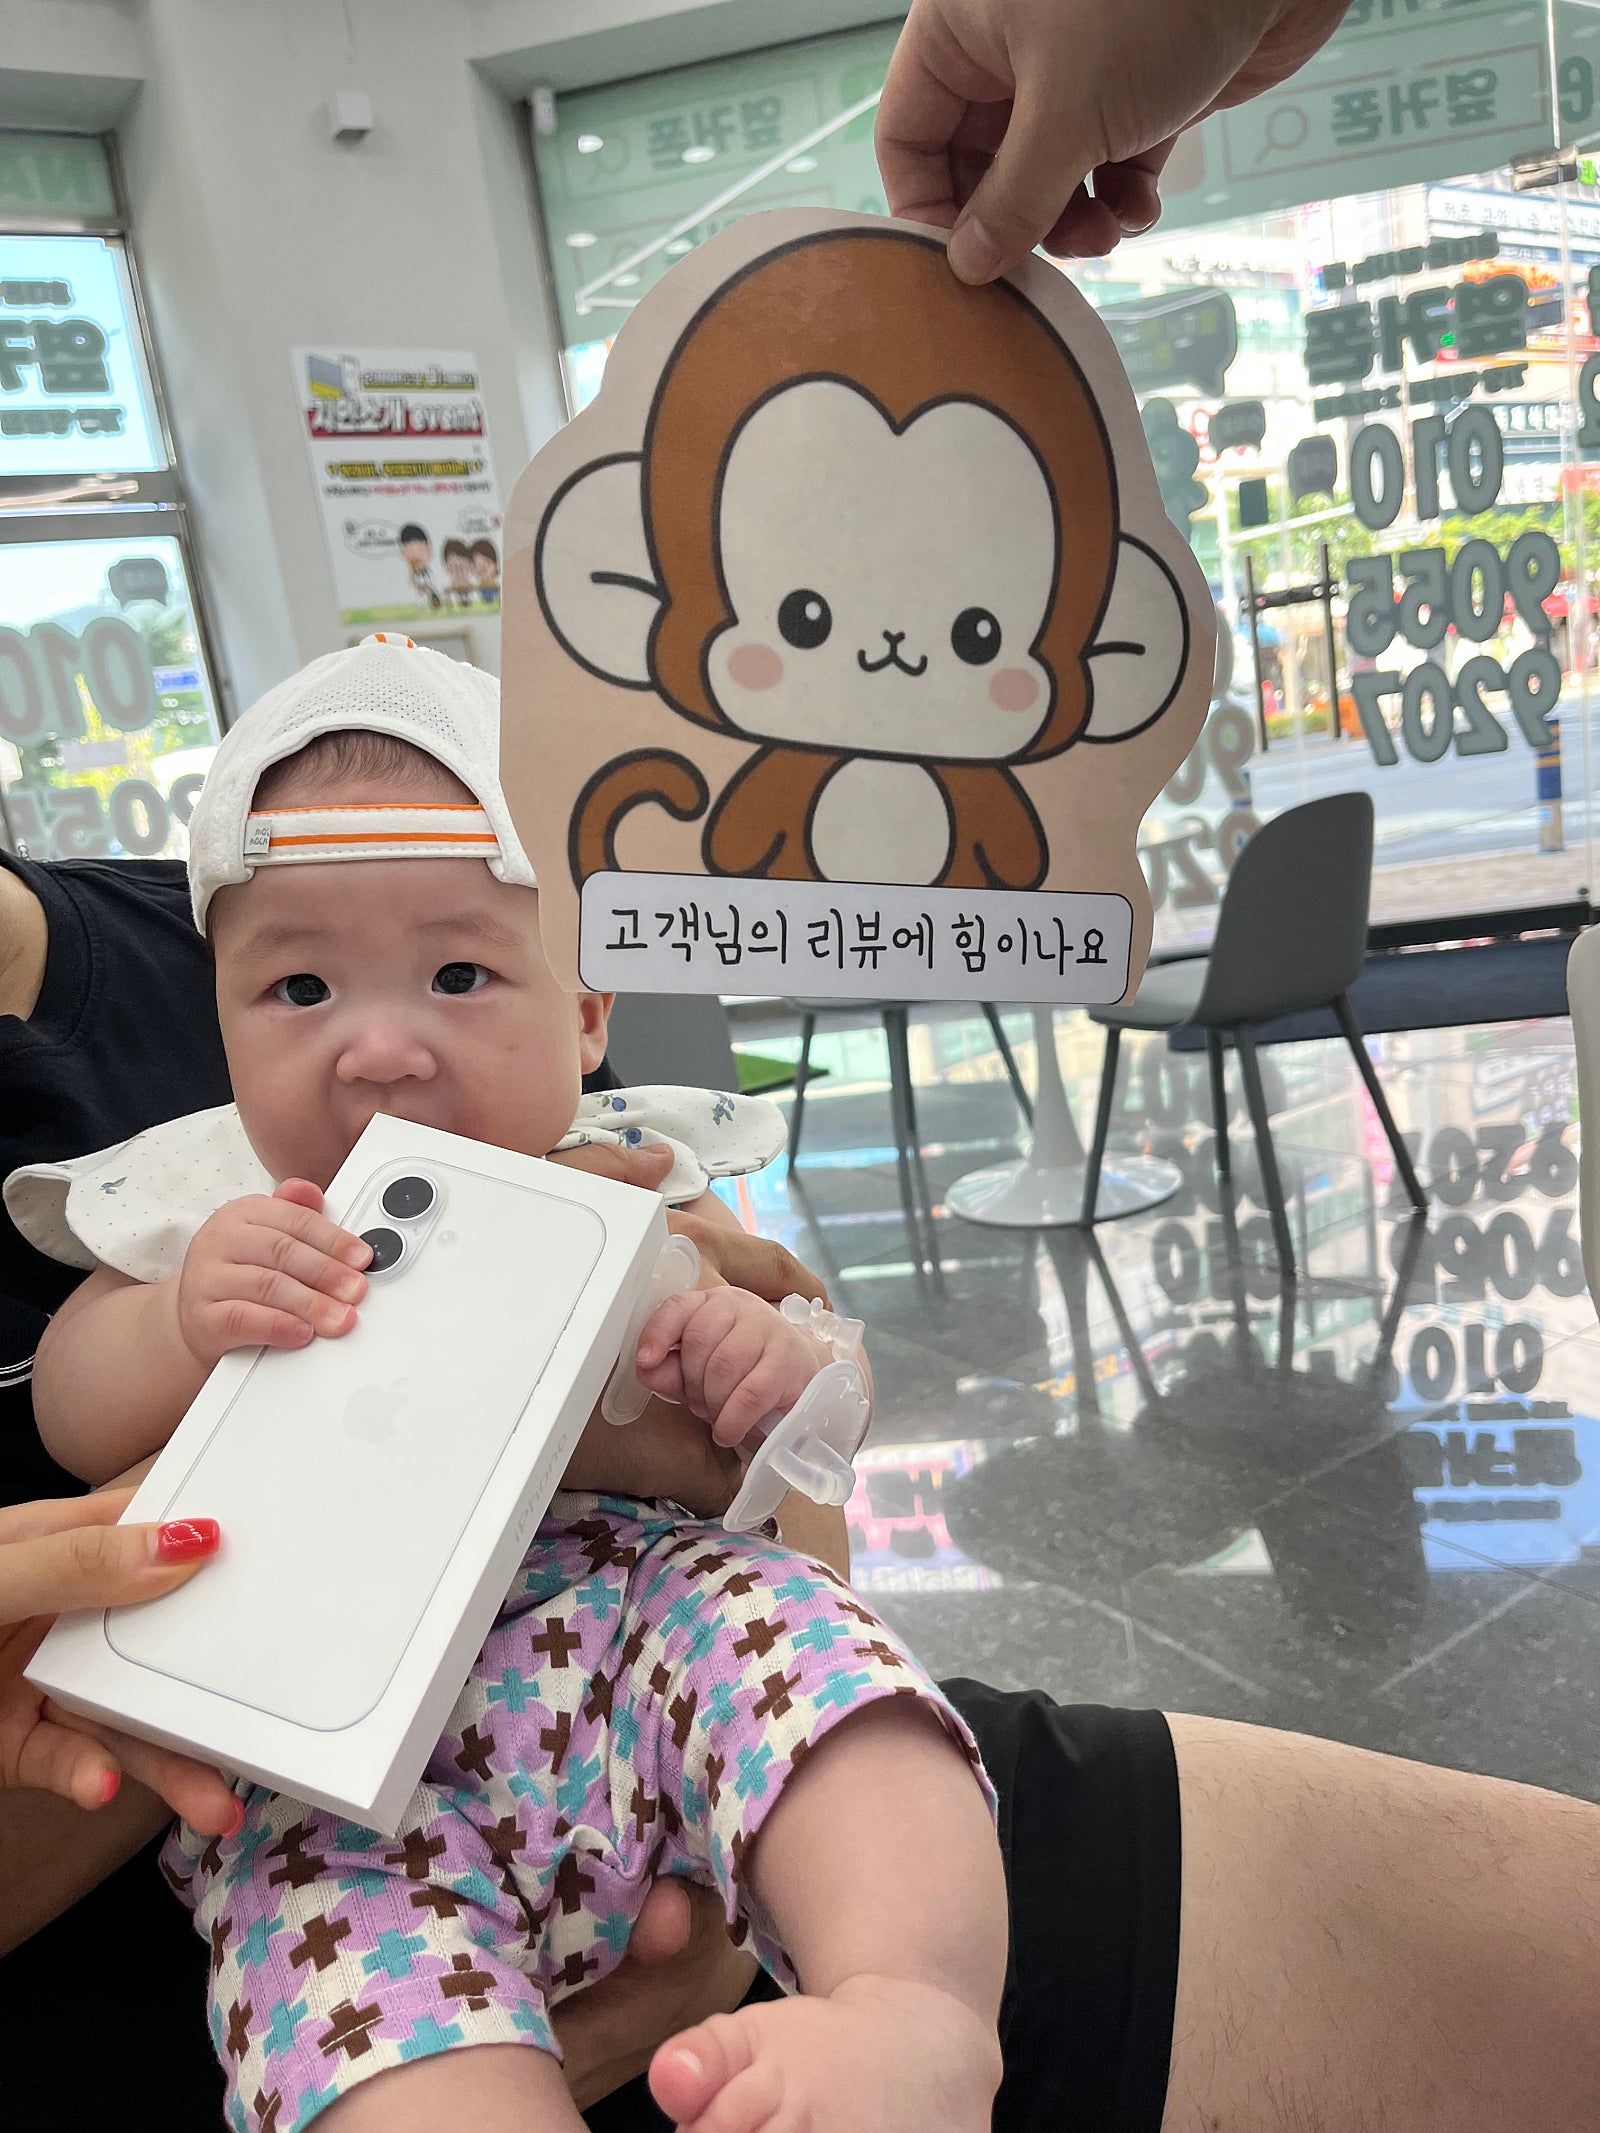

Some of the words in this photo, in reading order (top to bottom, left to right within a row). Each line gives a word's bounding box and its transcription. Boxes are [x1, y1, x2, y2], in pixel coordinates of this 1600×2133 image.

[605, 902, 788, 965] 고객님의
[807, 907, 935, 969] 리뷰에
[952, 912, 1109, 976] 힘이나요
